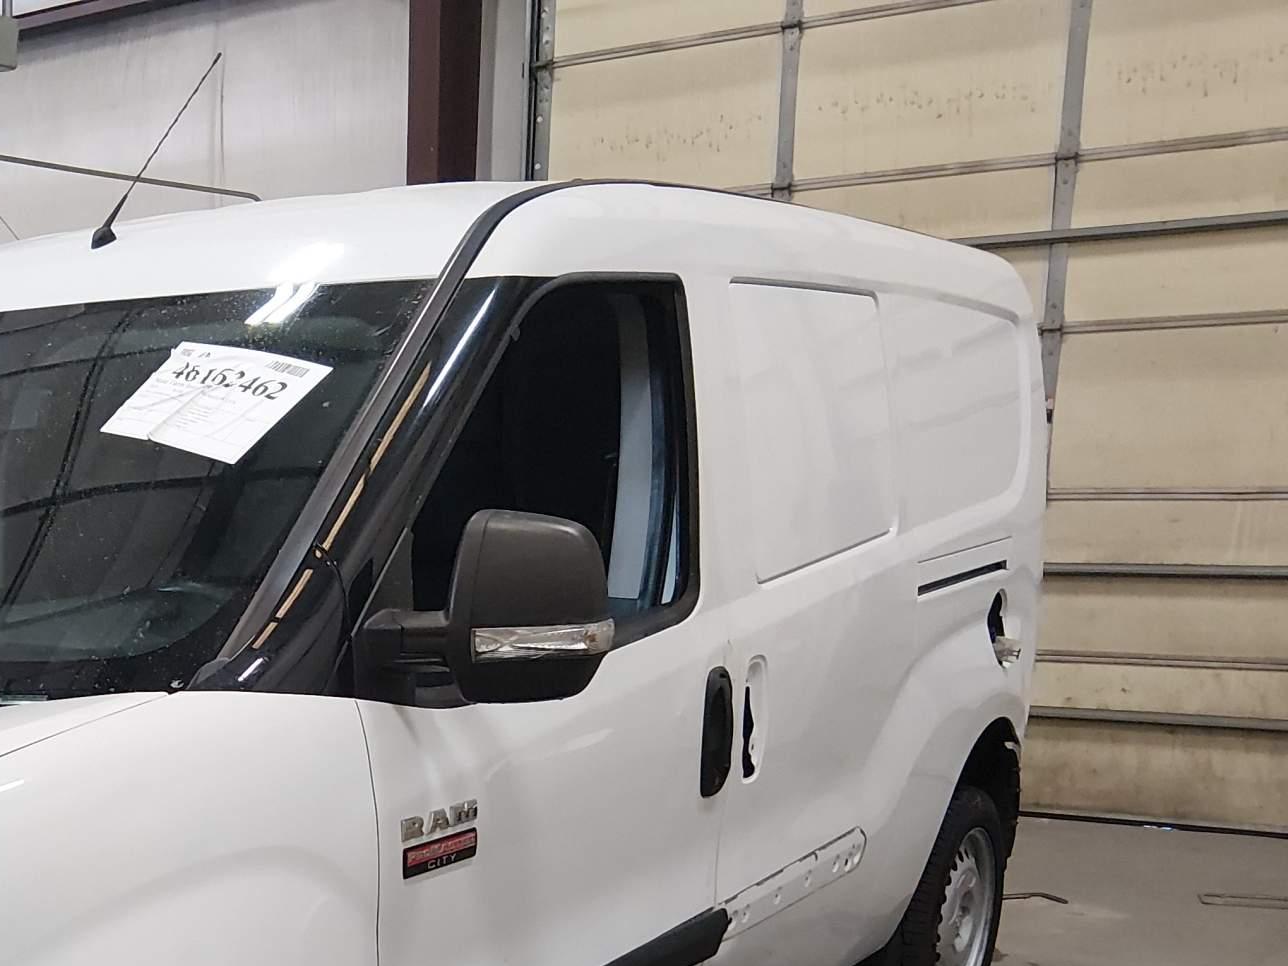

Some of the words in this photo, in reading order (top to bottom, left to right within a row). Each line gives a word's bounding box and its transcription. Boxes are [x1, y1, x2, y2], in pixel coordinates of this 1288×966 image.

[172, 361, 288, 400] 46162462
[400, 799, 478, 843] RAM
[427, 853, 457, 869] CITY
